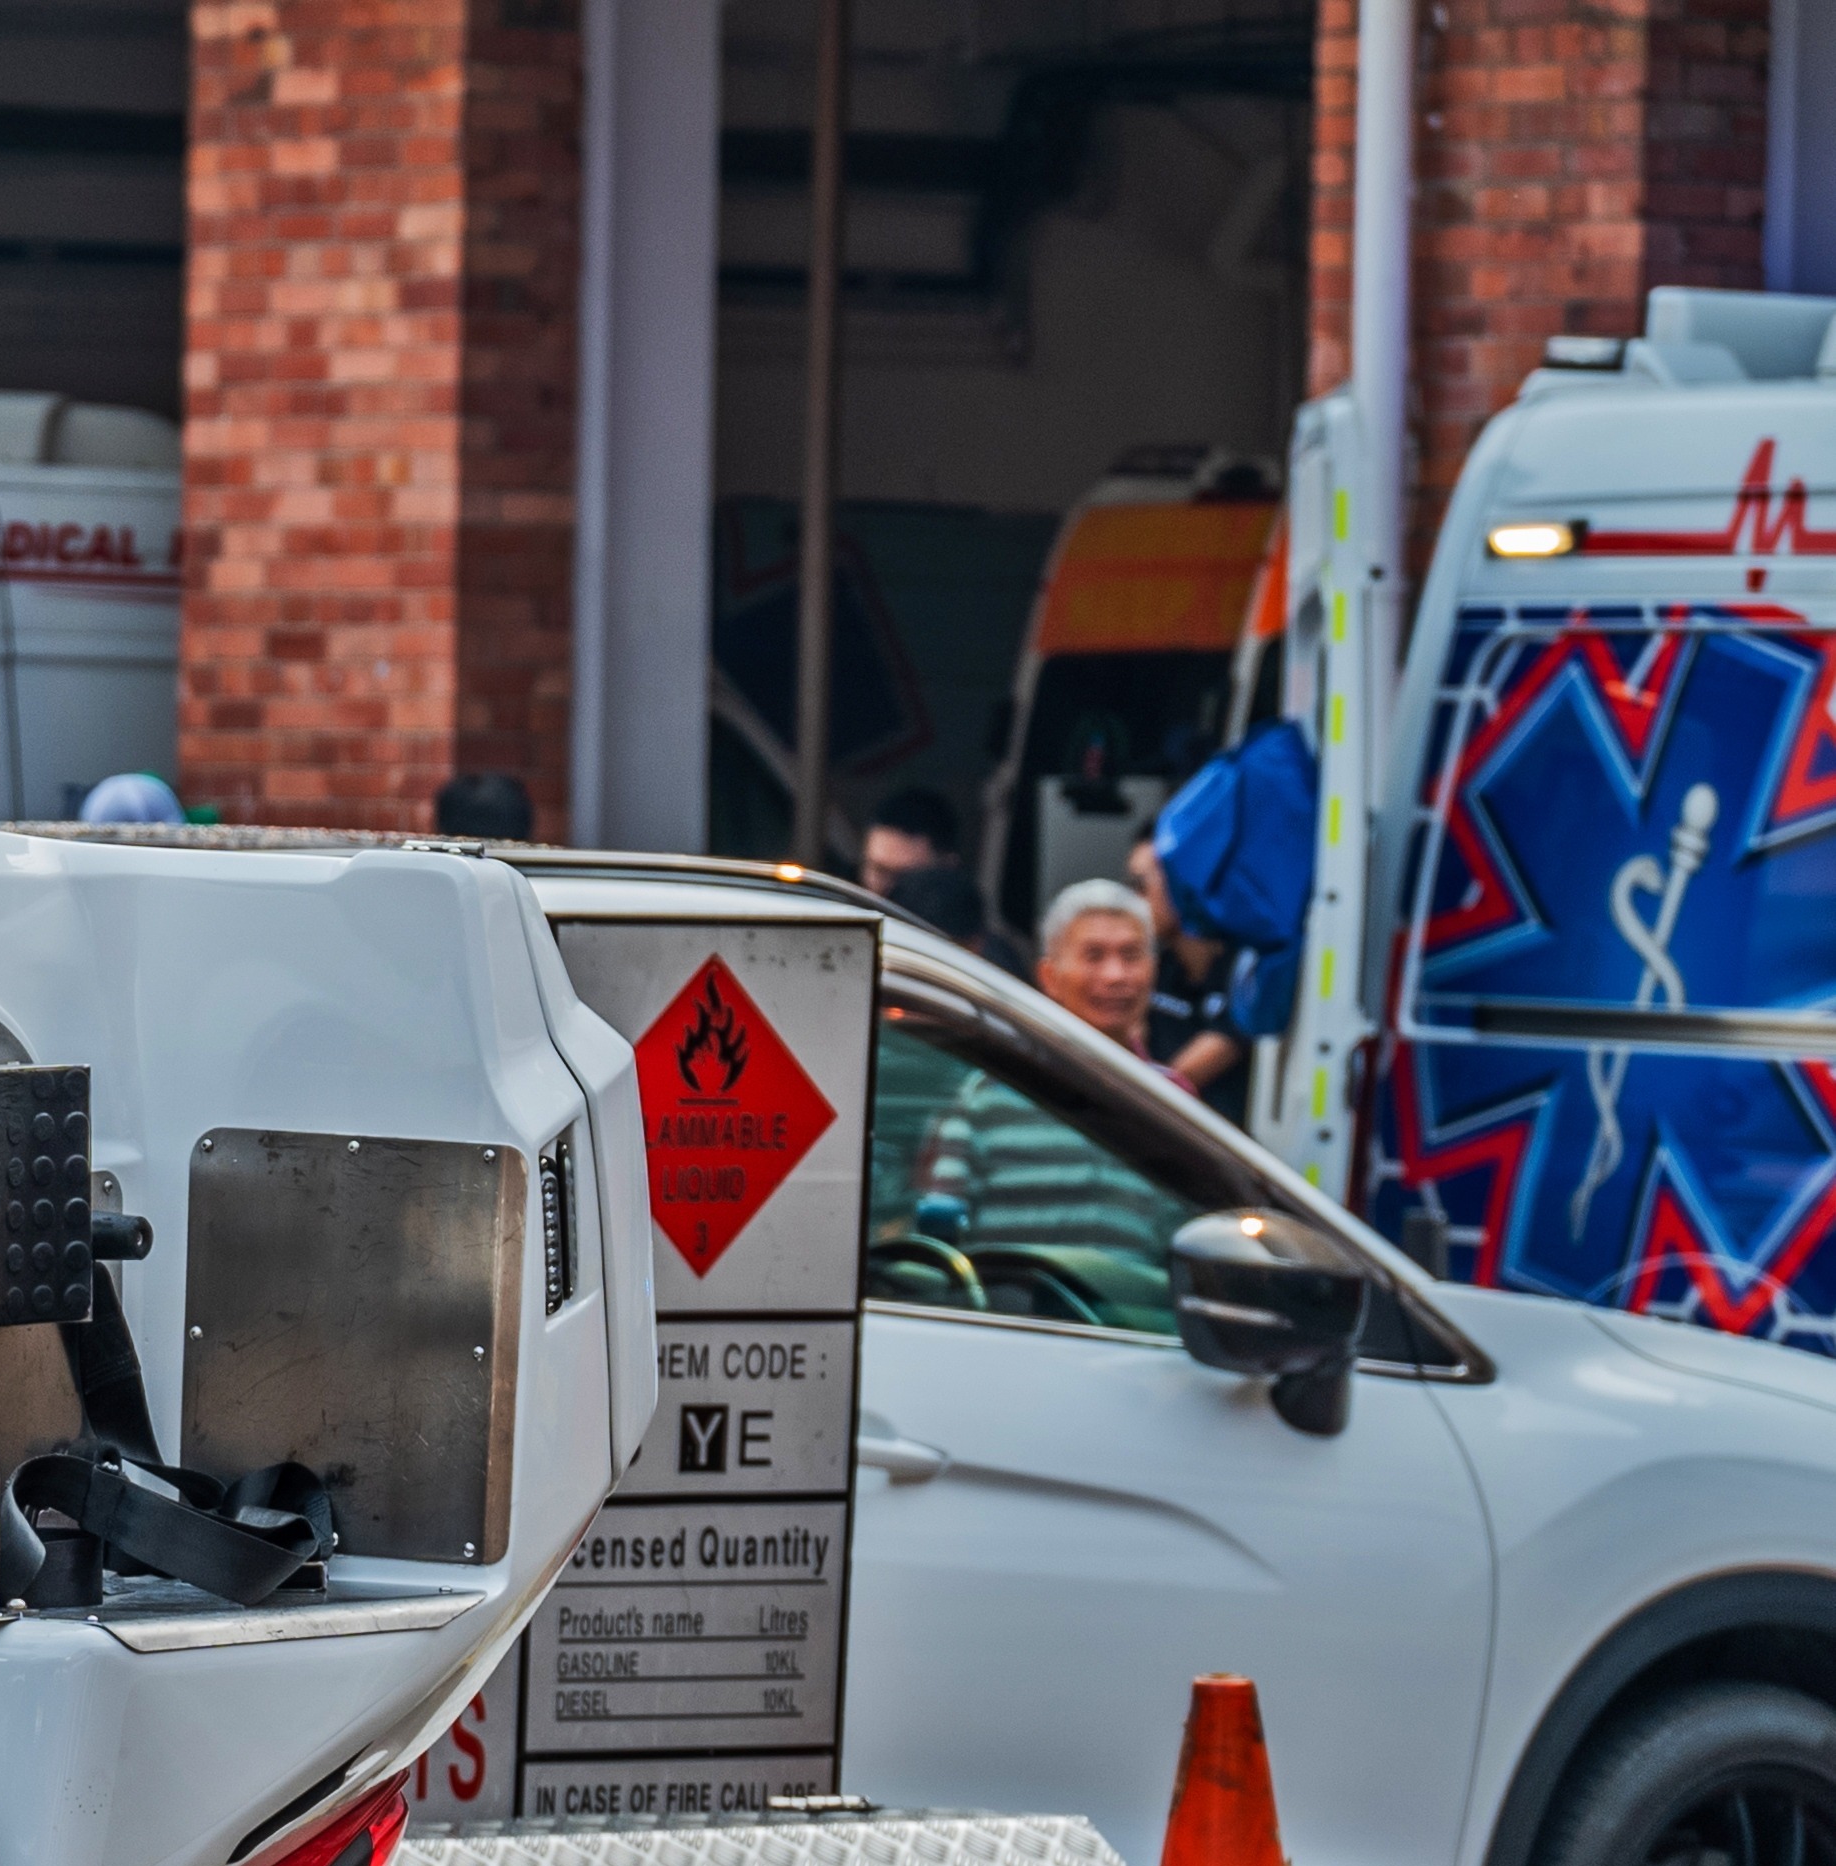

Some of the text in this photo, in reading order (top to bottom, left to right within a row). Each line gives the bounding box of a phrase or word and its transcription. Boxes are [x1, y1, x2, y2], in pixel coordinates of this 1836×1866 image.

[722, 1342, 807, 1381] CODE
[698, 1525, 829, 1577] Quantity
[651, 1610, 705, 1636] name
[758, 1605, 810, 1634] Litres
[556, 1650, 640, 1677] GASOLINE
[555, 1689, 611, 1716] DIESEL
[535, 1788, 556, 1815] IN
[564, 1785, 621, 1814] CASE
[630, 1783, 659, 1813] OF
[665, 1783, 712, 1812] FIRE
[720, 1781, 769, 1812] CALL
